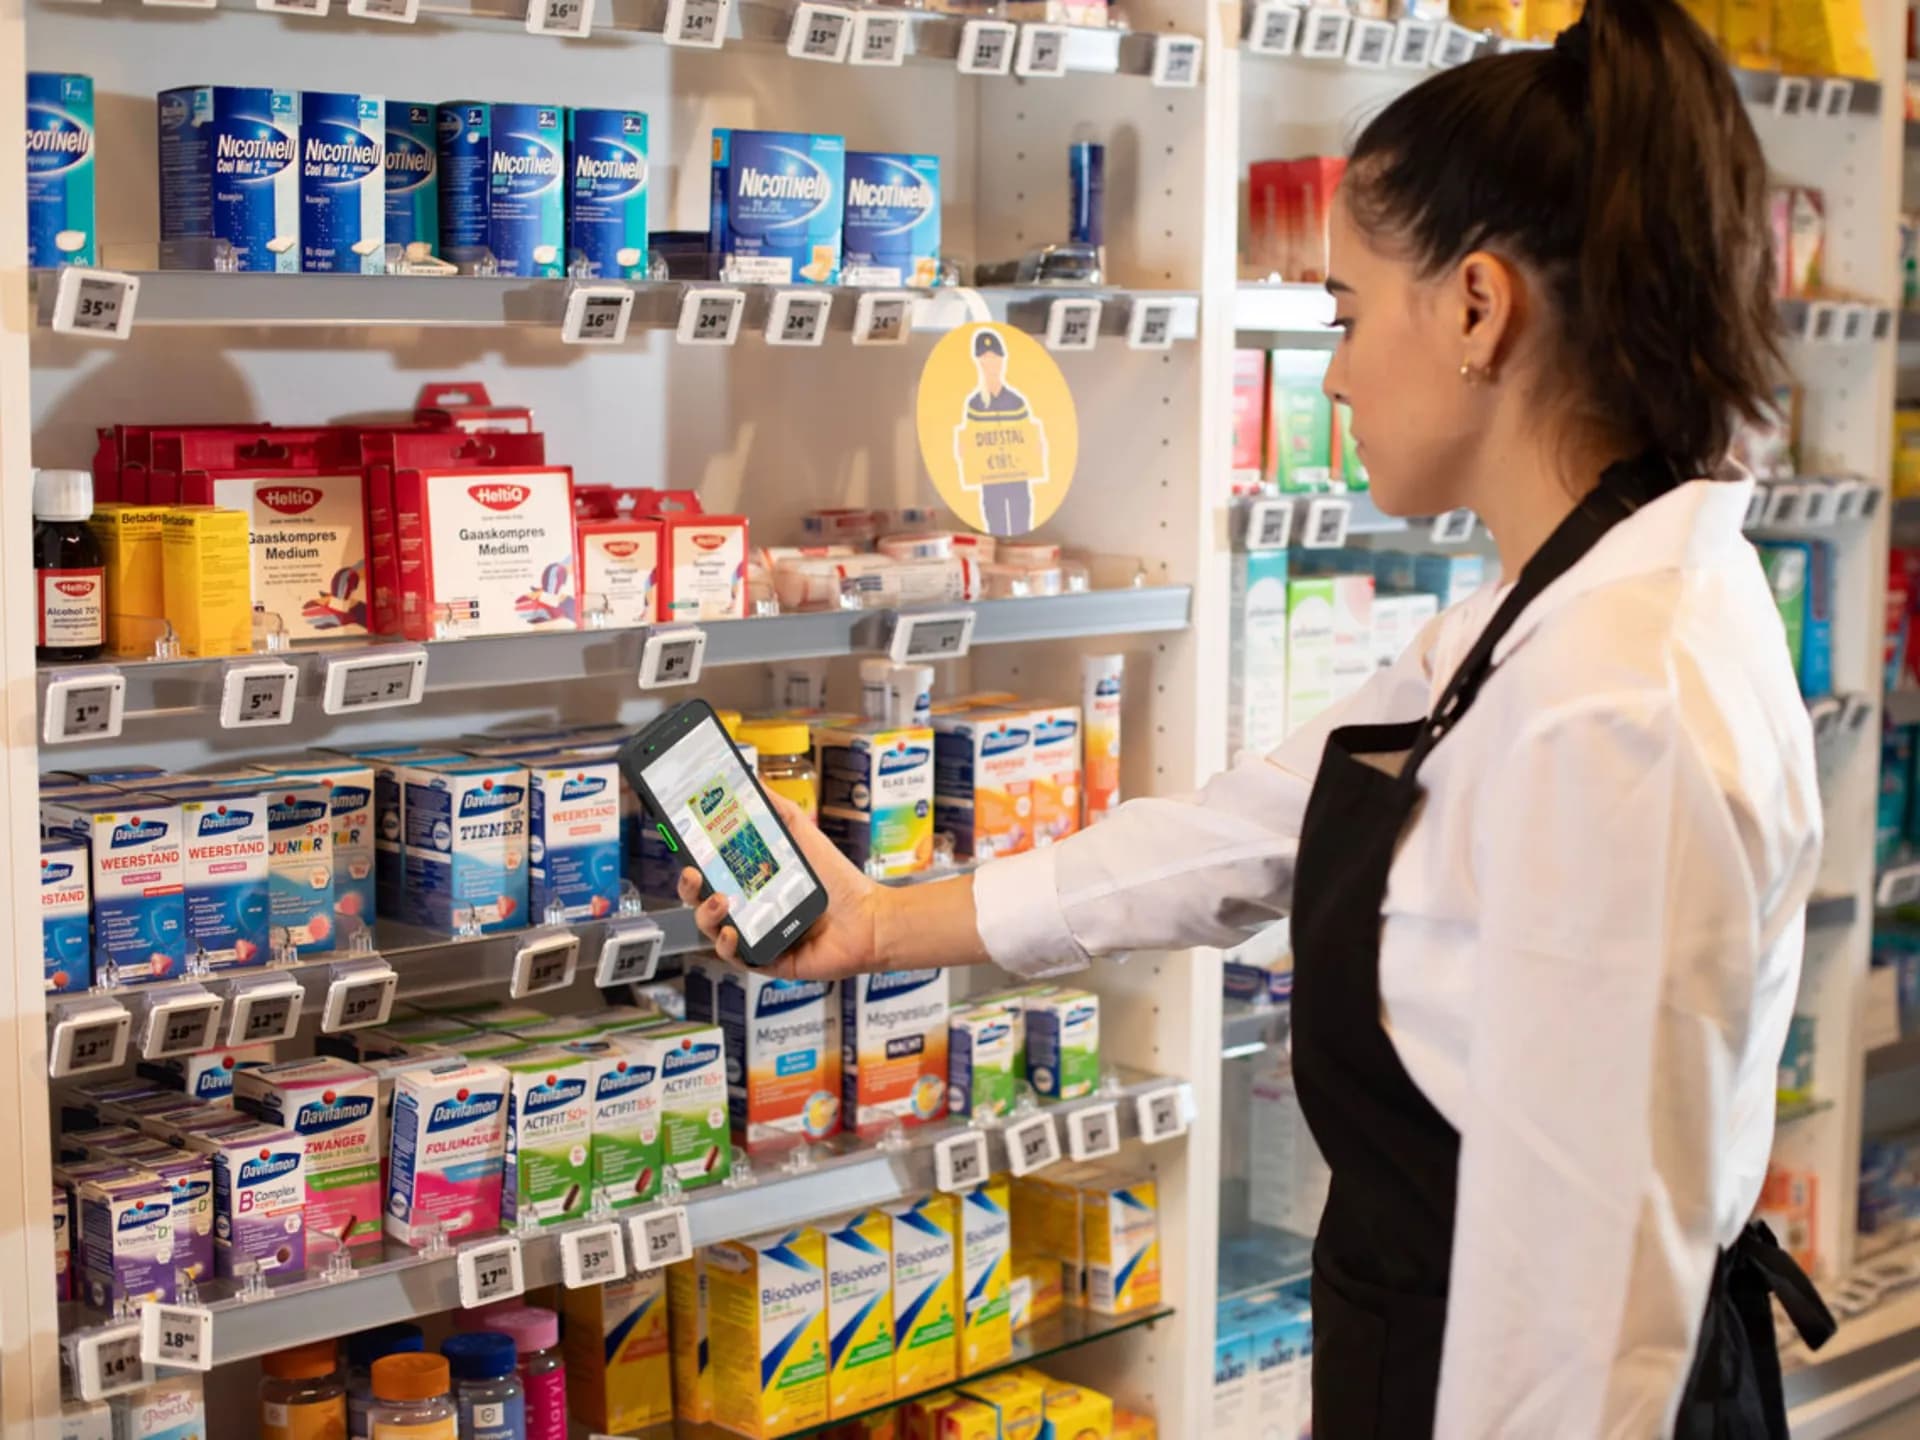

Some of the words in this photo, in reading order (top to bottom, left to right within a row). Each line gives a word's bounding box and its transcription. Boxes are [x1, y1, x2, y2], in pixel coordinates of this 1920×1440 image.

[217, 159, 235, 174] Cool
[236, 160, 252, 174] Mint
[305, 163, 321, 177] Cool
[323, 163, 339, 177] Mint
[459, 527, 545, 541] Gaaskompres
[265, 547, 319, 560] Medium
[478, 543, 529, 556] Medium
[47, 607, 83, 616] Alcohol
[552, 806, 617, 824] WEERSTAND
[459, 820, 524, 841] TIENER
[188, 841, 265, 860] WEERSTAND
[100, 851, 180, 871] WEERSTAND
[866, 1002, 944, 1030] Magnesium
[755, 1016, 837, 1045] Magnesium
[663, 1076, 703, 1095] ACTIFIT
[301, 1103, 369, 1126] Davitamon
[433, 1100, 498, 1124] Davitamon
[596, 1100, 637, 1120] ACTIFIT
[522, 1111, 566, 1131] ACTIFIT
[304, 1133, 367, 1155] ZWANGER
[425, 1132, 501, 1156] FOLIUMZUUR
[242, 1157, 296, 1180] Davitamon
[239, 1190, 255, 1214] B
[254, 1185, 297, 1202] Complex
[121, 1207, 167, 1226] Davitamon
[896, 1243, 950, 1269] Bisolvon
[830, 1261, 888, 1288] Bisolvon
[762, 1278, 822, 1307] Bisolvon
